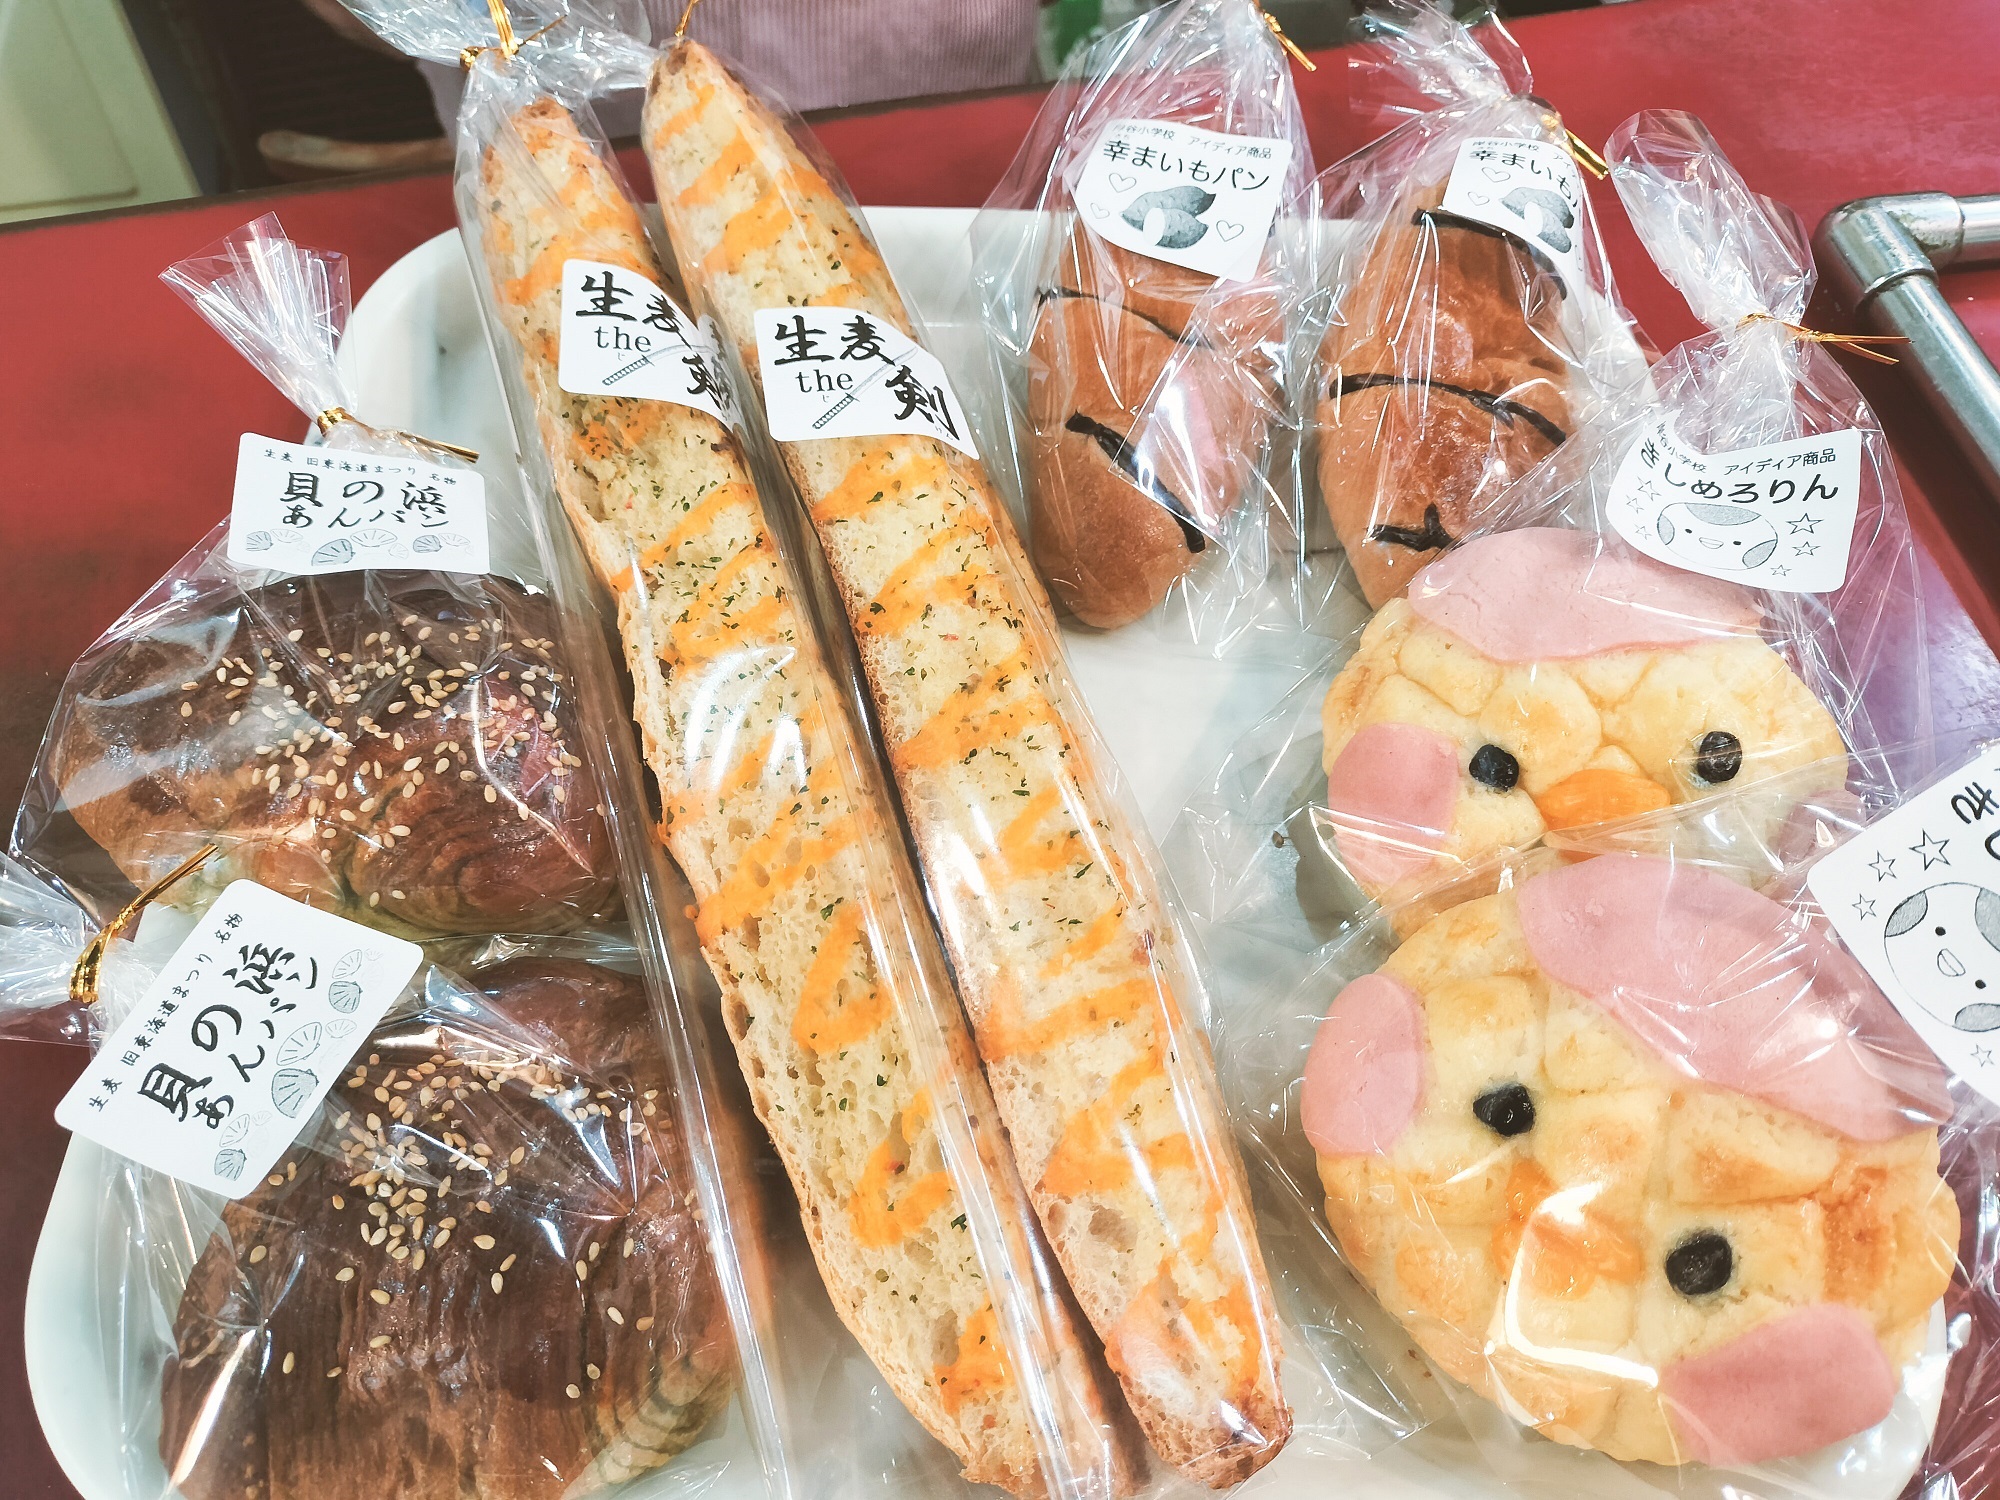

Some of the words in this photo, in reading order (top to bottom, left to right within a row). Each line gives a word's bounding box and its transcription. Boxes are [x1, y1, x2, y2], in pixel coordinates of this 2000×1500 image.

[1103, 140, 1270, 191] 幸まいもパン
[1187, 136, 1272, 159] アイディア商品
[576, 271, 693, 350] 生麦
[594, 325, 652, 353] the
[774, 315, 896, 367] 生麦
[795, 369, 854, 393] the
[885, 365, 960, 440] 剣
[264, 449, 293, 463] 生麦
[306, 456, 416, 475] 旧東海道まつり
[429, 472, 457, 486] 名物
[1640, 437, 1839, 505] ましめろりん
[1723, 447, 1837, 476] アイディア商品
[279, 471, 447, 515] 貝の浜
[282, 505, 449, 529] あんパン
[1950, 781, 2000, 861] ま
[89, 1078, 122, 1113] 生麦
[120, 953, 214, 1067] 旧東海道まつり
[214, 913, 243, 944] 名物
[137, 942, 300, 1122] 貝の浜
[192, 956, 319, 1130] あんパン
